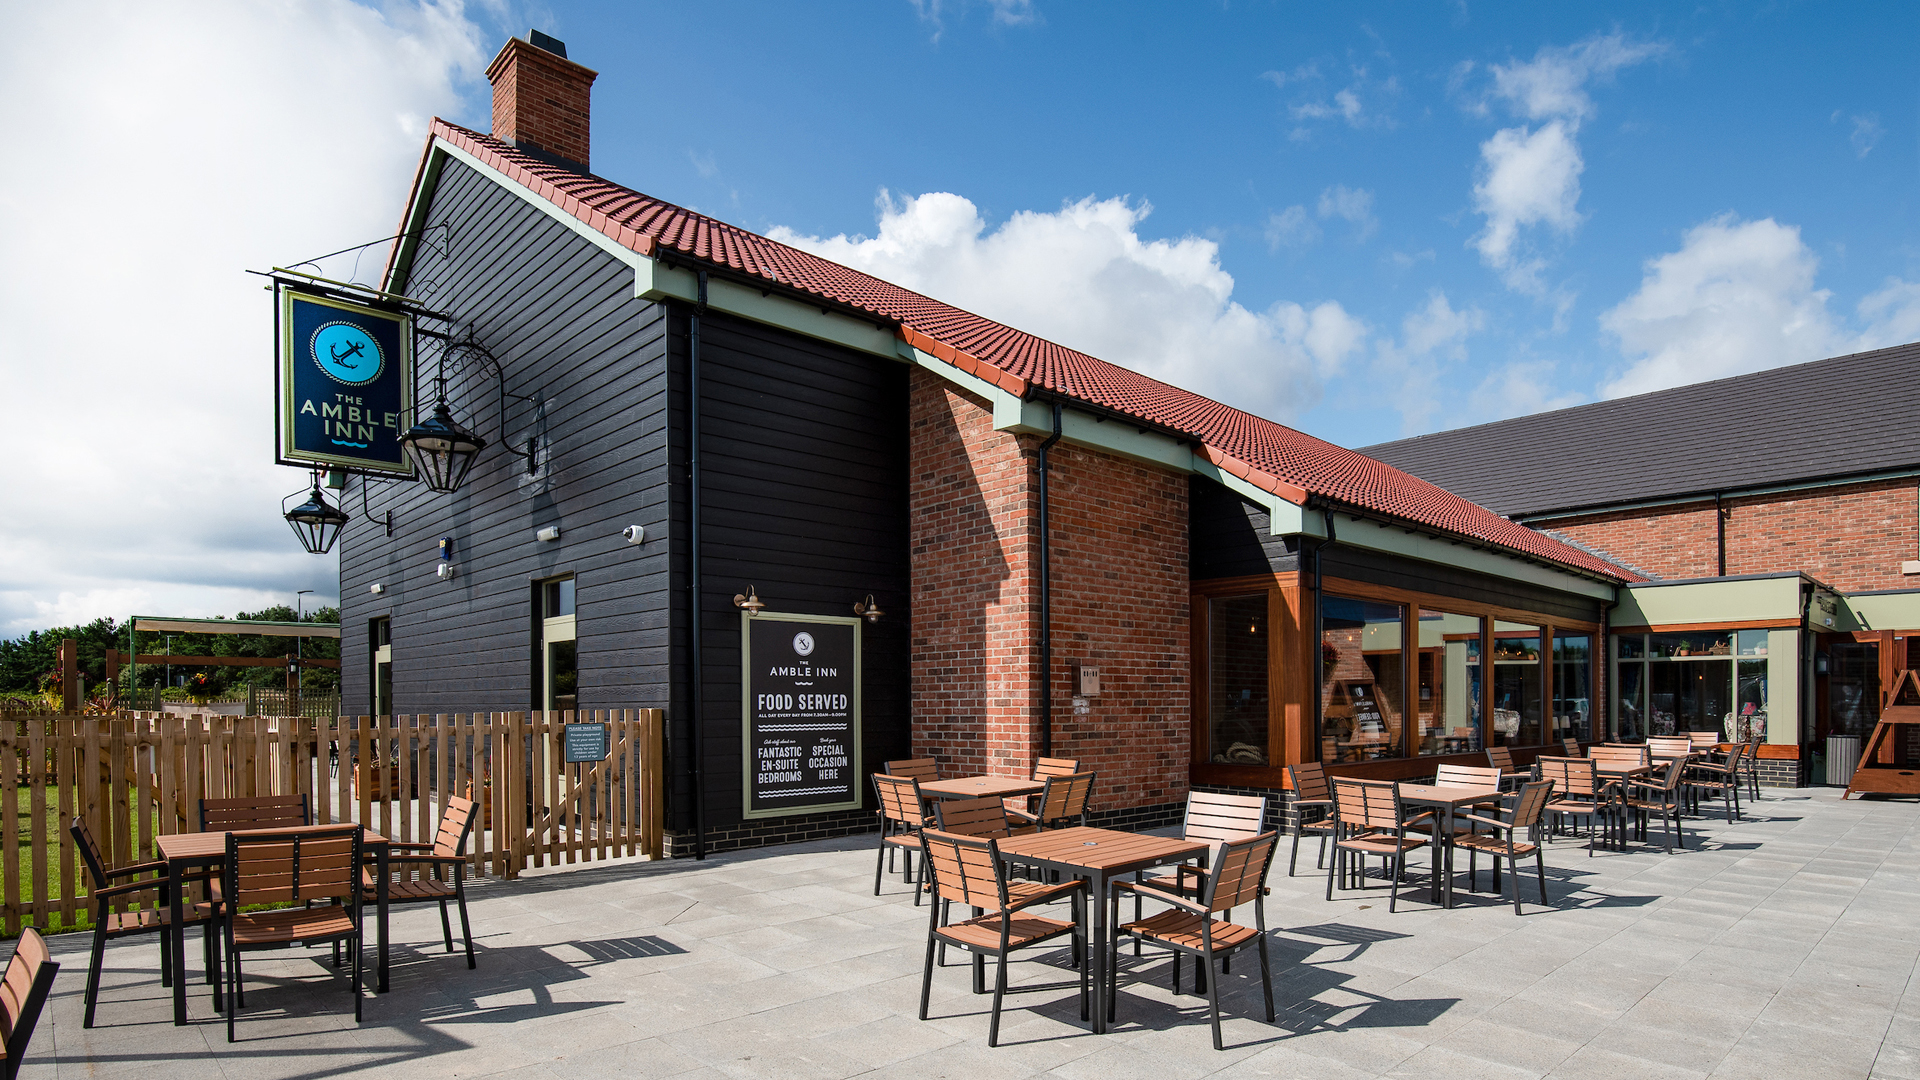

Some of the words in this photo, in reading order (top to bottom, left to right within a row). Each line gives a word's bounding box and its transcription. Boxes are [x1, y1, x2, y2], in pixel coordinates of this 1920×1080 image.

[335, 393, 363, 406] THE
[300, 399, 397, 429] AMBLE
[324, 419, 374, 442] INN
[769, 666, 812, 677] AMBLE
[816, 667, 838, 677] INN
[757, 694, 793, 711] FOOD
[798, 693, 848, 710] SERVED
[758, 746, 802, 759] FANTASTIC
[812, 744, 845, 756] SPECIAL
[761, 758, 799, 772] EN-SUITE
[808, 756, 848, 769] OCCASION
[758, 771, 802, 784] BEDROOMS
[818, 768, 839, 780] HERE
